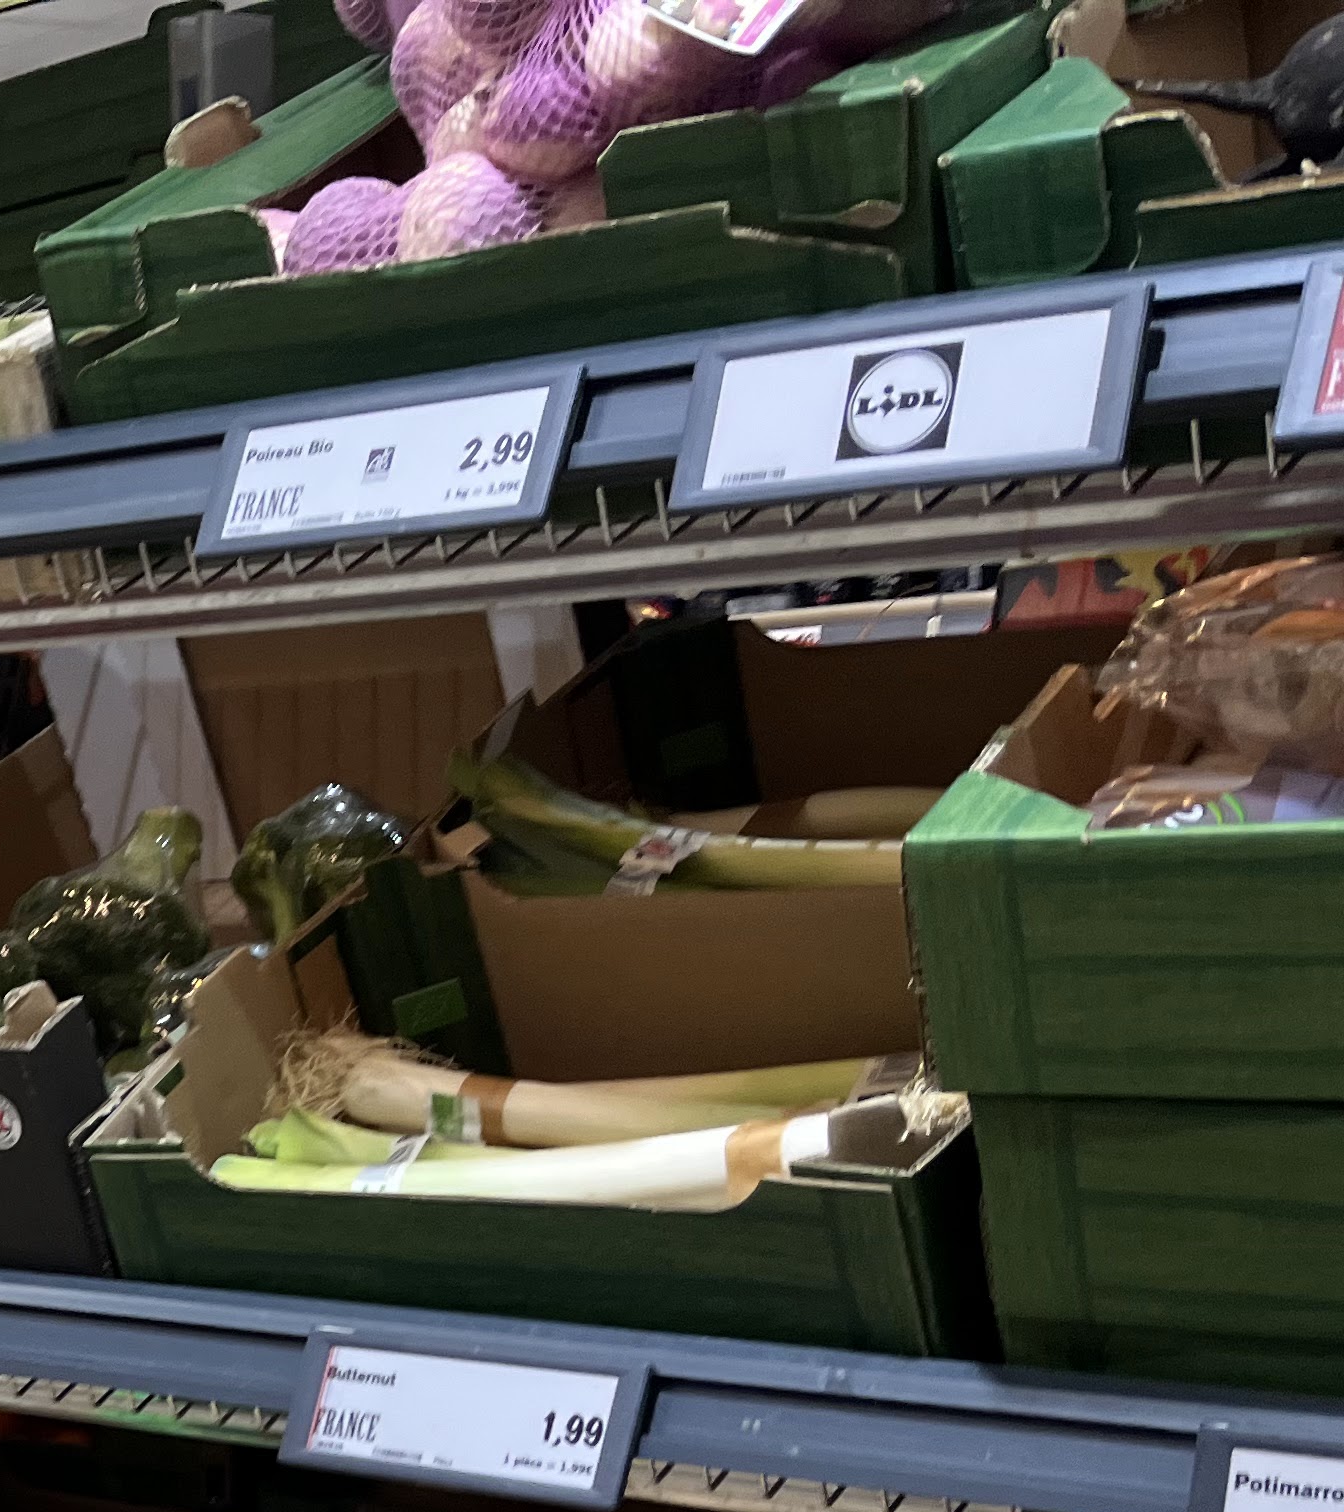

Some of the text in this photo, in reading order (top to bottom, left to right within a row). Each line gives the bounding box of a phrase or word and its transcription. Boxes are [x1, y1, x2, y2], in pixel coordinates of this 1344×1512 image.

[245, 439, 334, 465] Poireau Bio
[458, 430, 534, 472] 2,99
[230, 485, 305, 523] FRANCE
[327, 1365, 397, 1387] Butternut
[314, 1406, 382, 1443] FRANCE
[543, 1409, 604, 1448] 1,99
